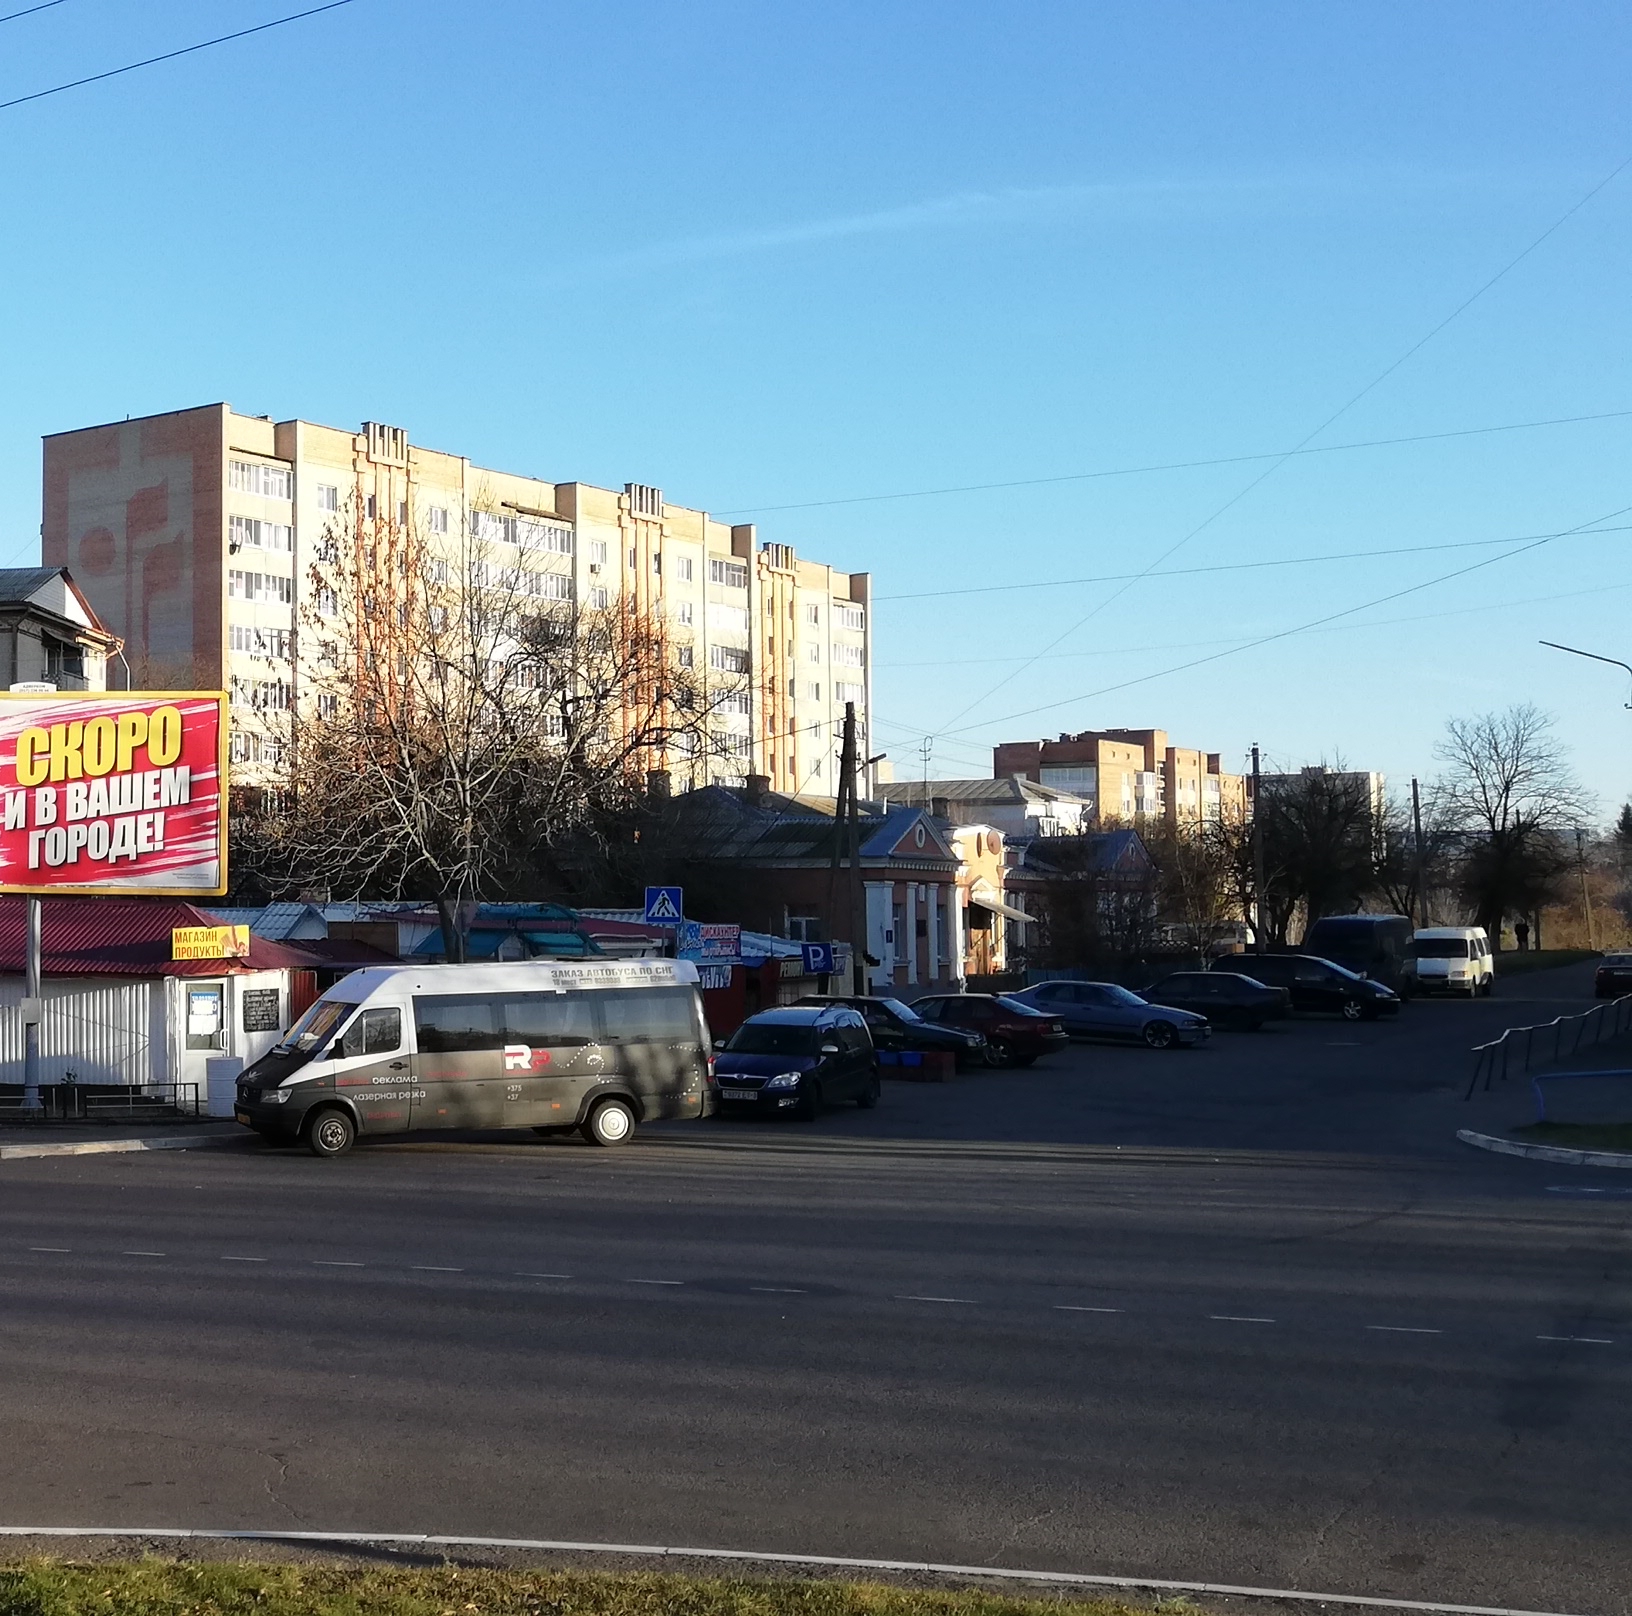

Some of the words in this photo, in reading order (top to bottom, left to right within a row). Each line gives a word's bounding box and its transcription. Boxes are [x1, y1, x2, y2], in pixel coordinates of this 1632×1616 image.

[16, 705, 182, 786] СКОРО
[4, 790, 26, 831] И
[35, 786, 57, 826] В
[66, 765, 190, 822] ВАШЕМ
[28, 811, 165, 869] ГОРОДЕ!
[175, 931, 217, 943] МАГАЗИН
[175, 946, 225, 959] ПРОДУКТЫ
[551, 970, 584, 978] ЗАКАЗ
[586, 967, 636, 977] АВТОБУСА
[639, 967, 652, 975] ПО
[655, 966, 674, 975] СНГ
[353, 1092, 396, 1101] лазерная
[398, 1090, 426, 1100] резка
